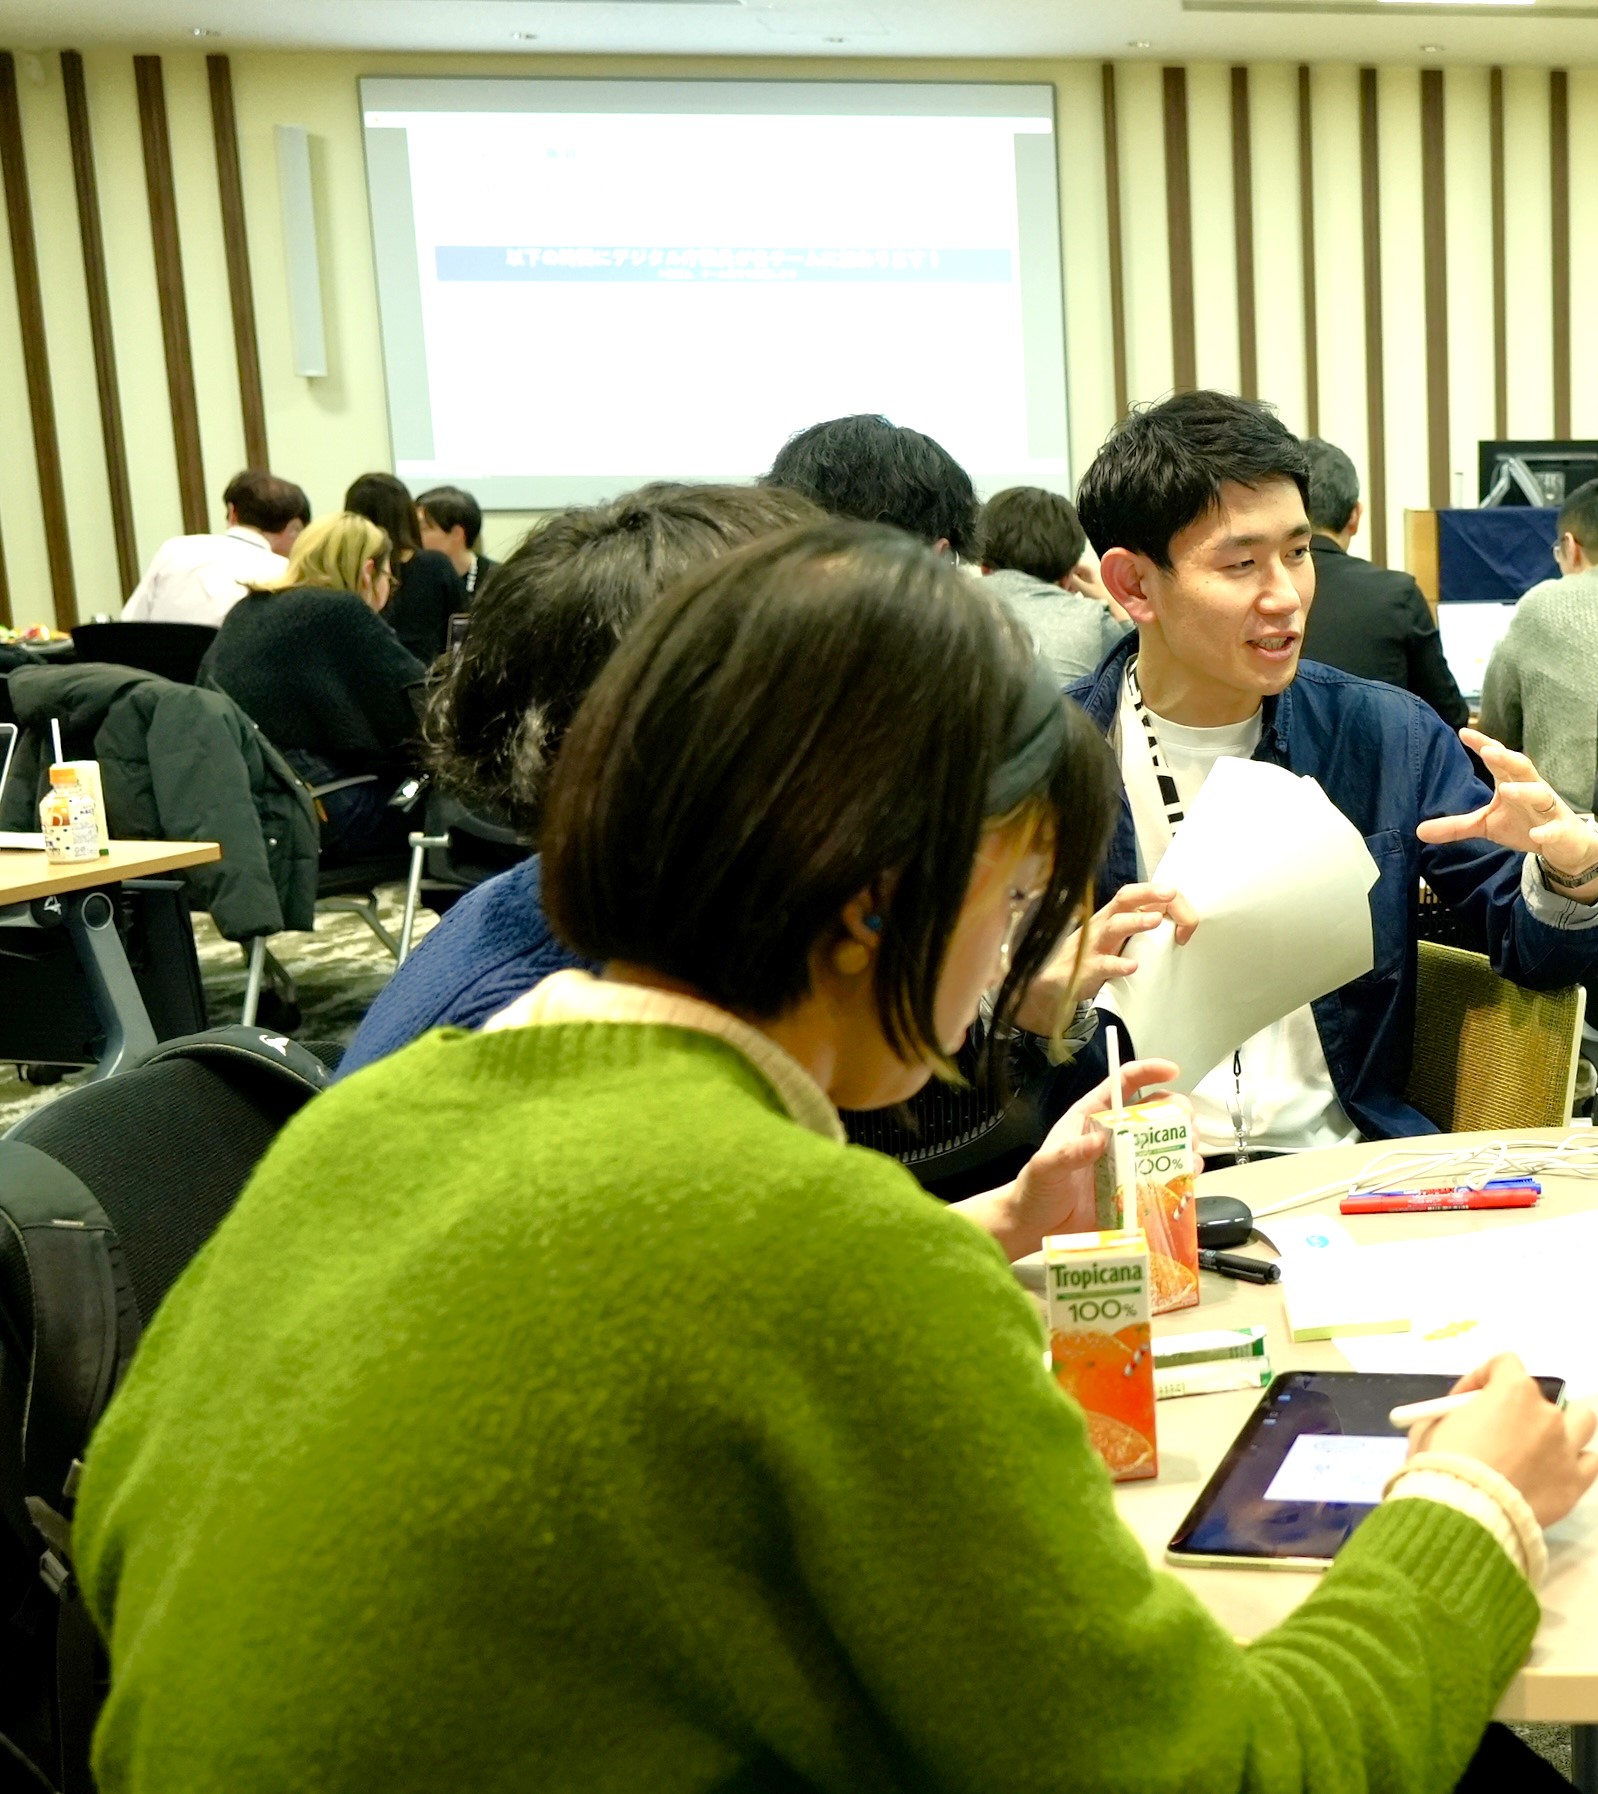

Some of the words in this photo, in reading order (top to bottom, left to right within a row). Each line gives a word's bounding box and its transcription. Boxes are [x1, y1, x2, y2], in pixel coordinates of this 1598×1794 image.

[1134, 1156, 1184, 1177] 00%
[1049, 1262, 1143, 1289] Tropicana
[1068, 1299, 1138, 1323] 100%
